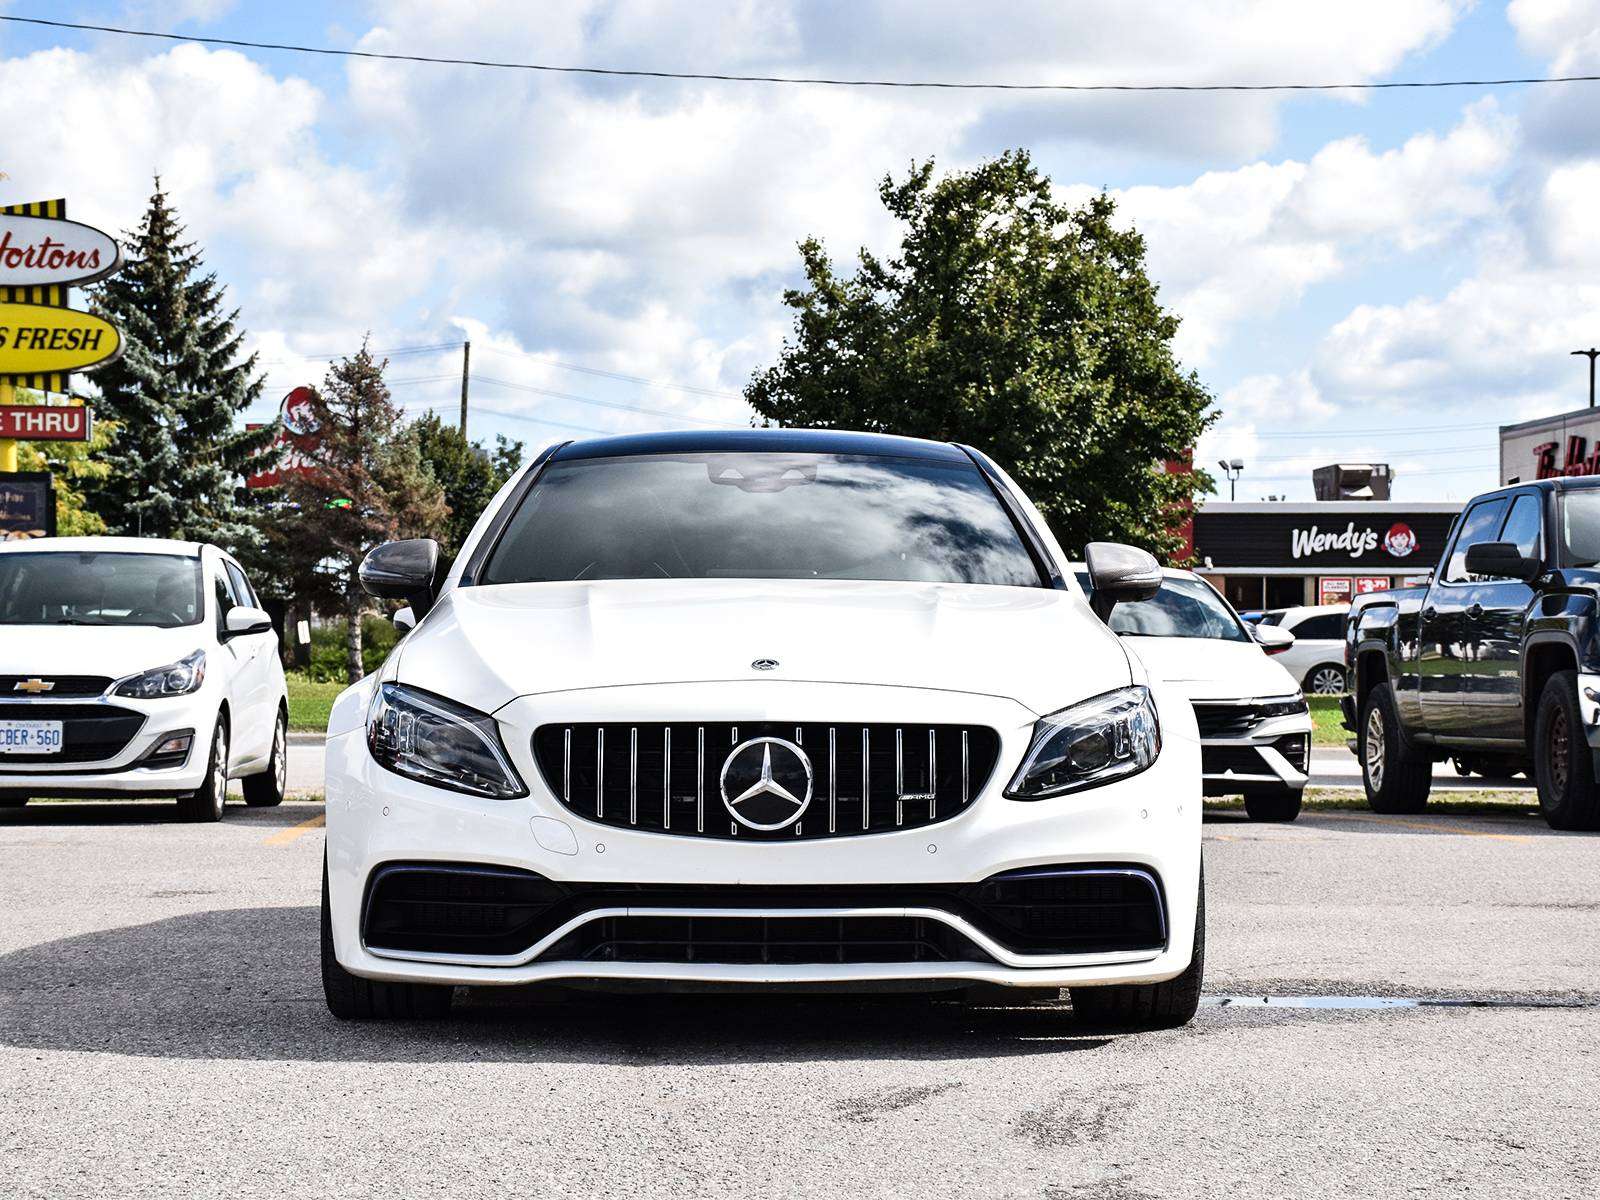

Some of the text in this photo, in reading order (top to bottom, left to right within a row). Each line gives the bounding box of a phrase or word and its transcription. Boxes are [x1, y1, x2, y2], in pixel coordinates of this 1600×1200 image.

[12, 327, 104, 350] FRESH
[10, 412, 80, 433] THRU
[1292, 522, 1378, 558] Wendy's
[36, 729, 60, 745] 560
